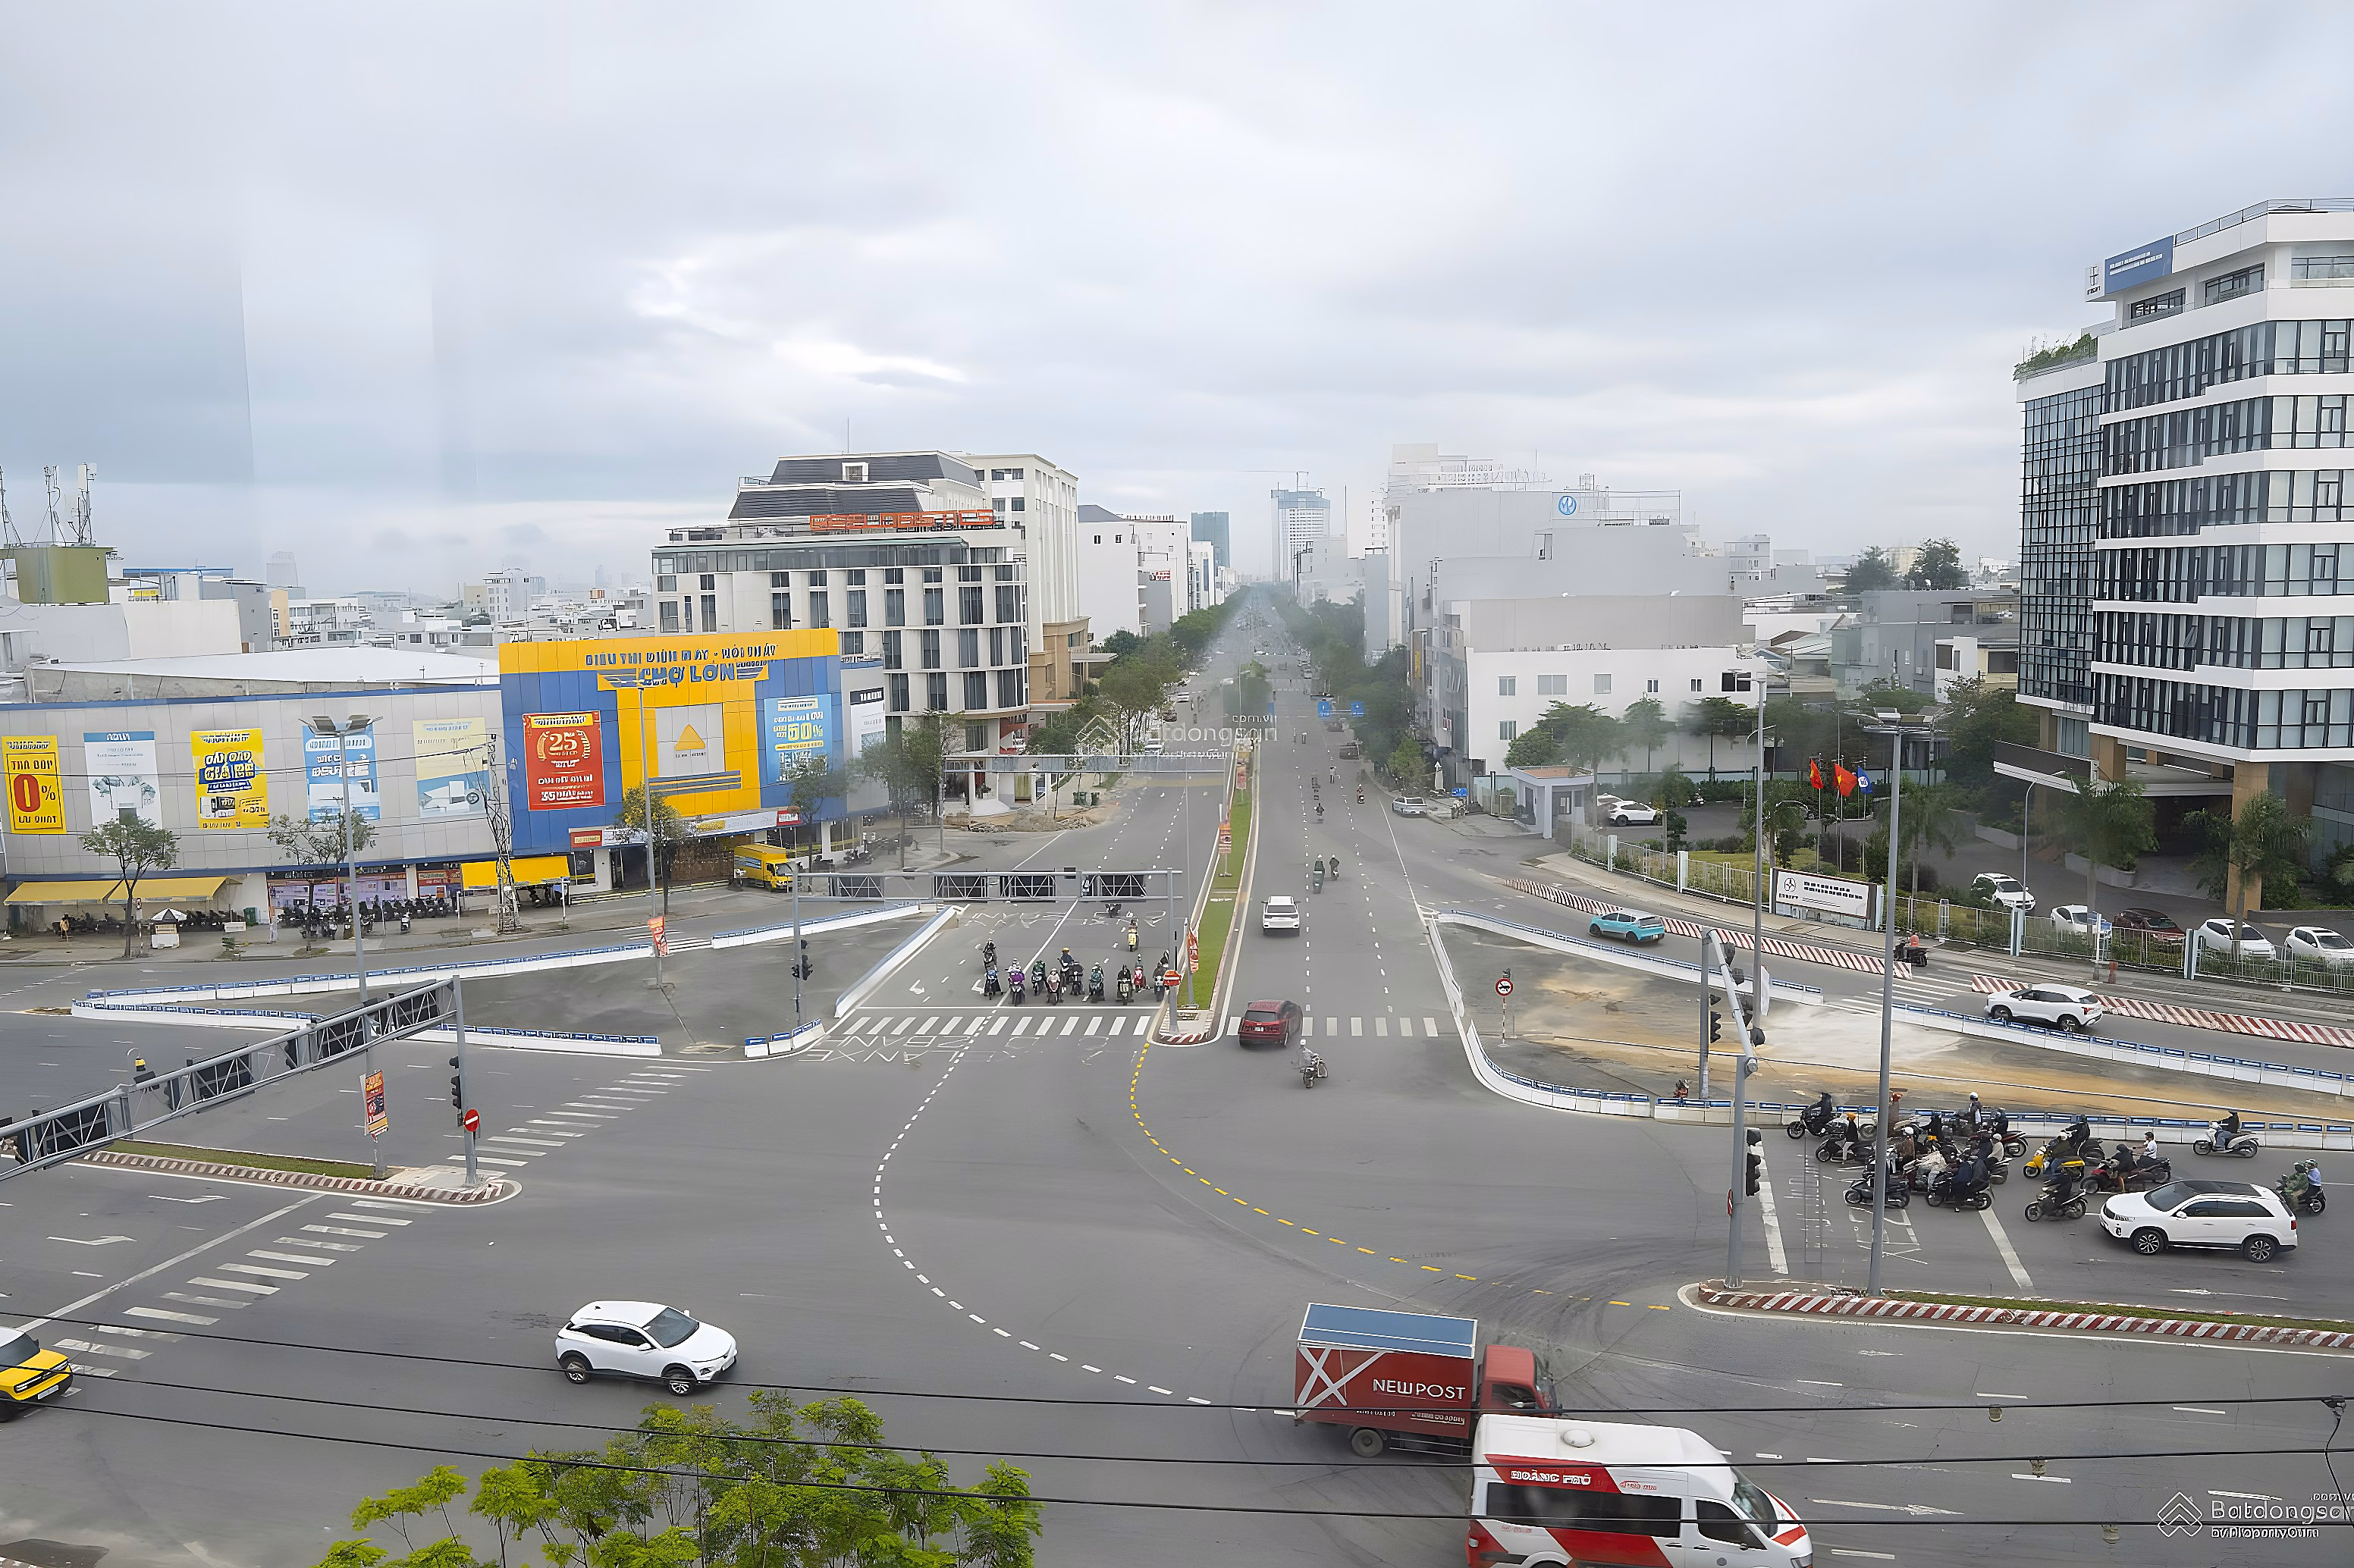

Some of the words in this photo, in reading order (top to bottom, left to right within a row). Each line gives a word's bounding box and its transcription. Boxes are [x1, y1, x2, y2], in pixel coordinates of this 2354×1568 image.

[689, 662, 736, 682] LỚN
[549, 732, 578, 751] 25
[1373, 1378, 1466, 1400] NEWPOST
